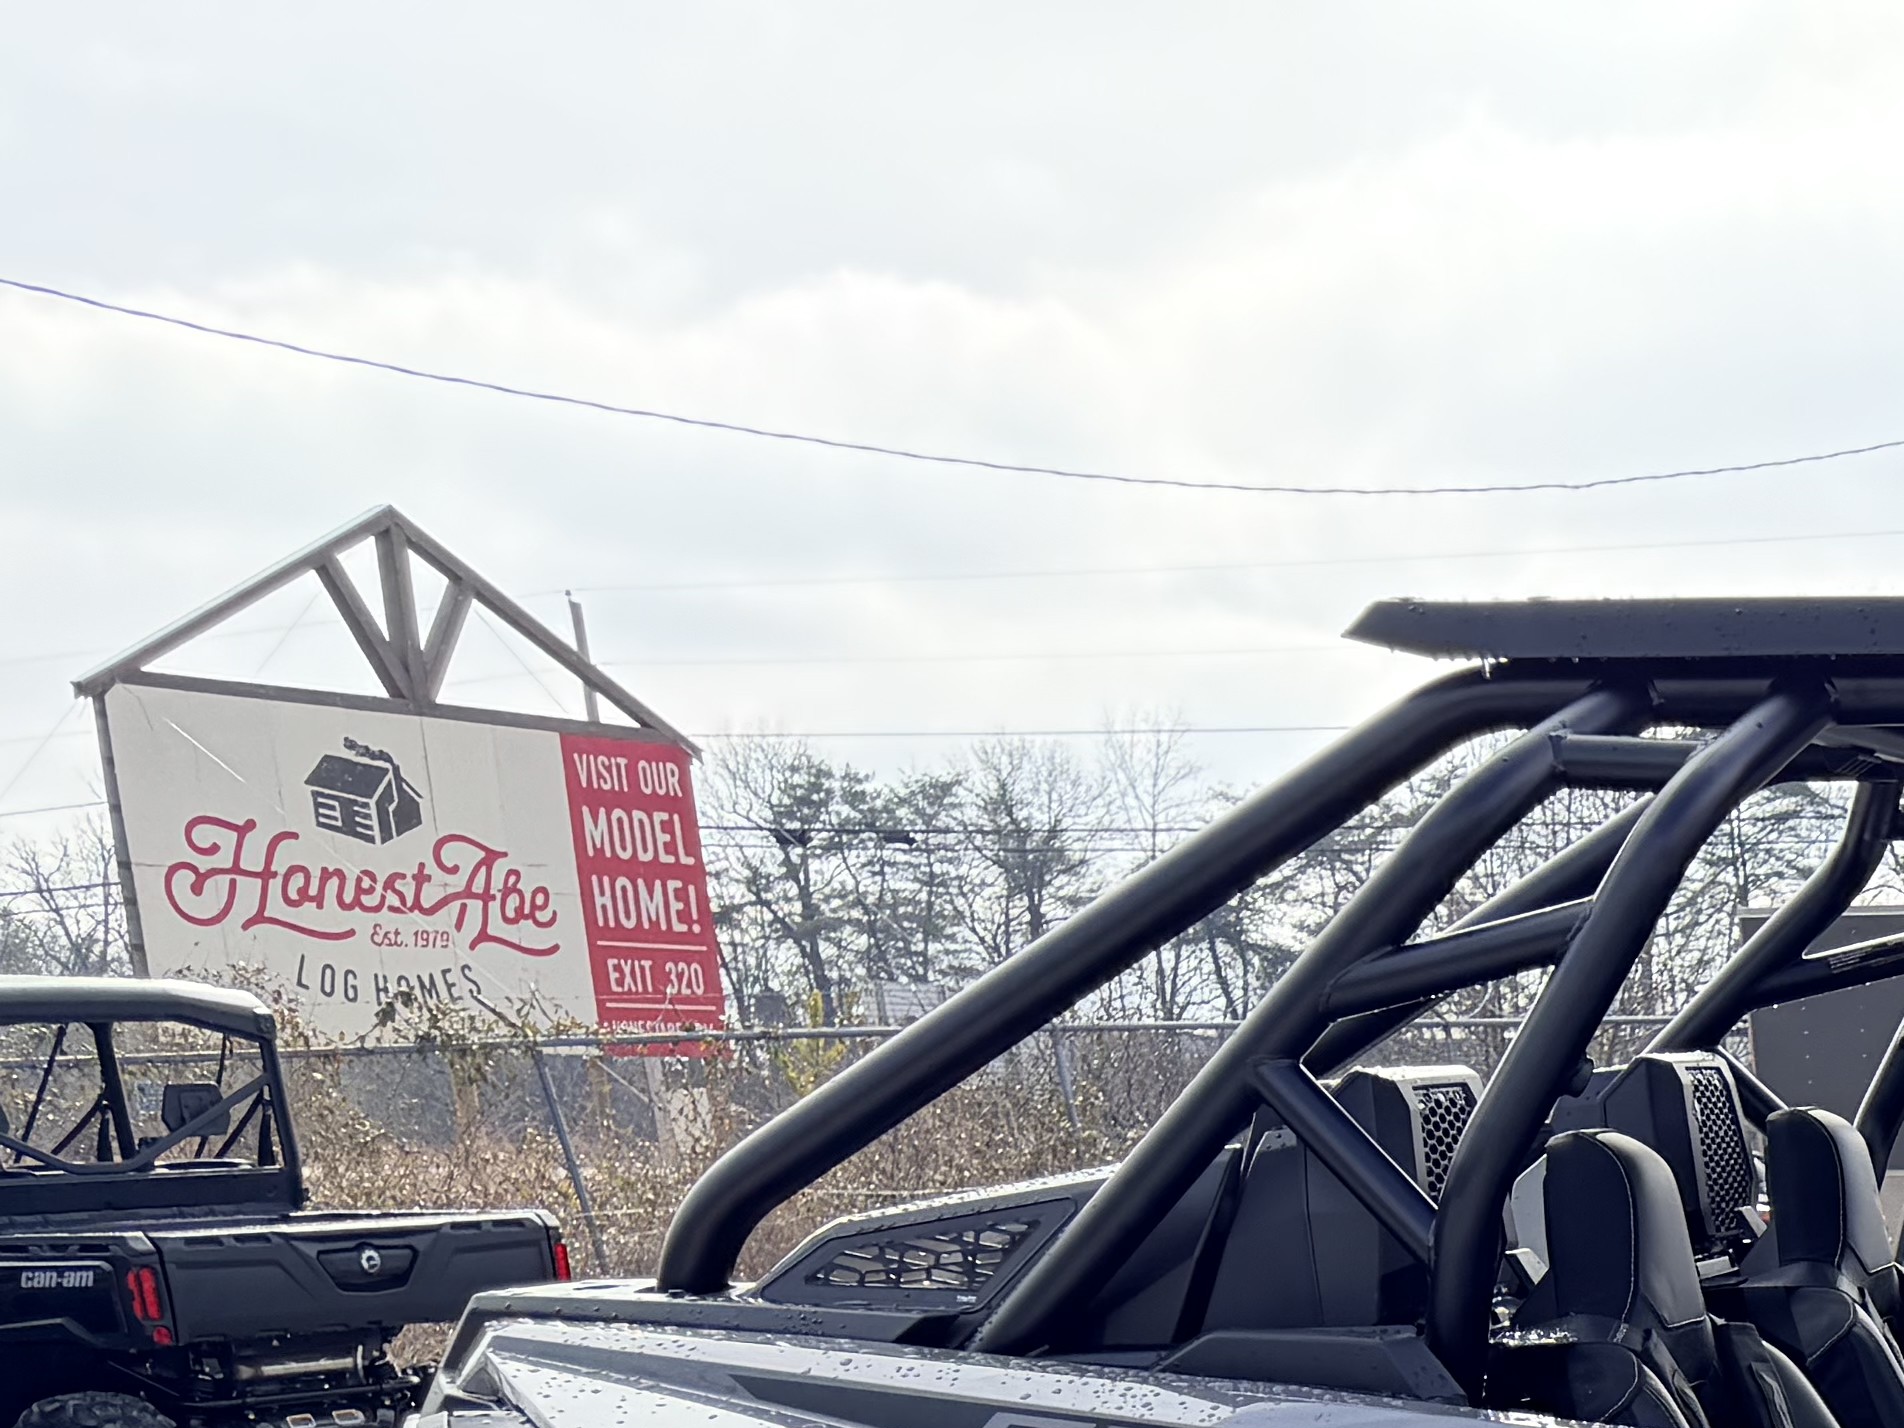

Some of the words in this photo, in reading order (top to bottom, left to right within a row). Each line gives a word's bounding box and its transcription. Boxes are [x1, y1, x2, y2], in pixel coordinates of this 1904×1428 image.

[573, 752, 629, 793] VISIT
[638, 759, 683, 798] OUR
[581, 804, 695, 866] MODEL
[164, 814, 433, 942] Honest
[431, 832, 562, 957] Abe
[590, 874, 702, 935] HOME!
[370, 923, 408, 949] Est.
[413, 929, 451, 949] 1979
[296, 954, 359, 1003] LOG
[374, 964, 482, 1009] HOMES
[606, 957, 653, 994] EXIT
[664, 961, 705, 997] 320
[20, 1270, 94, 1288] can-am
